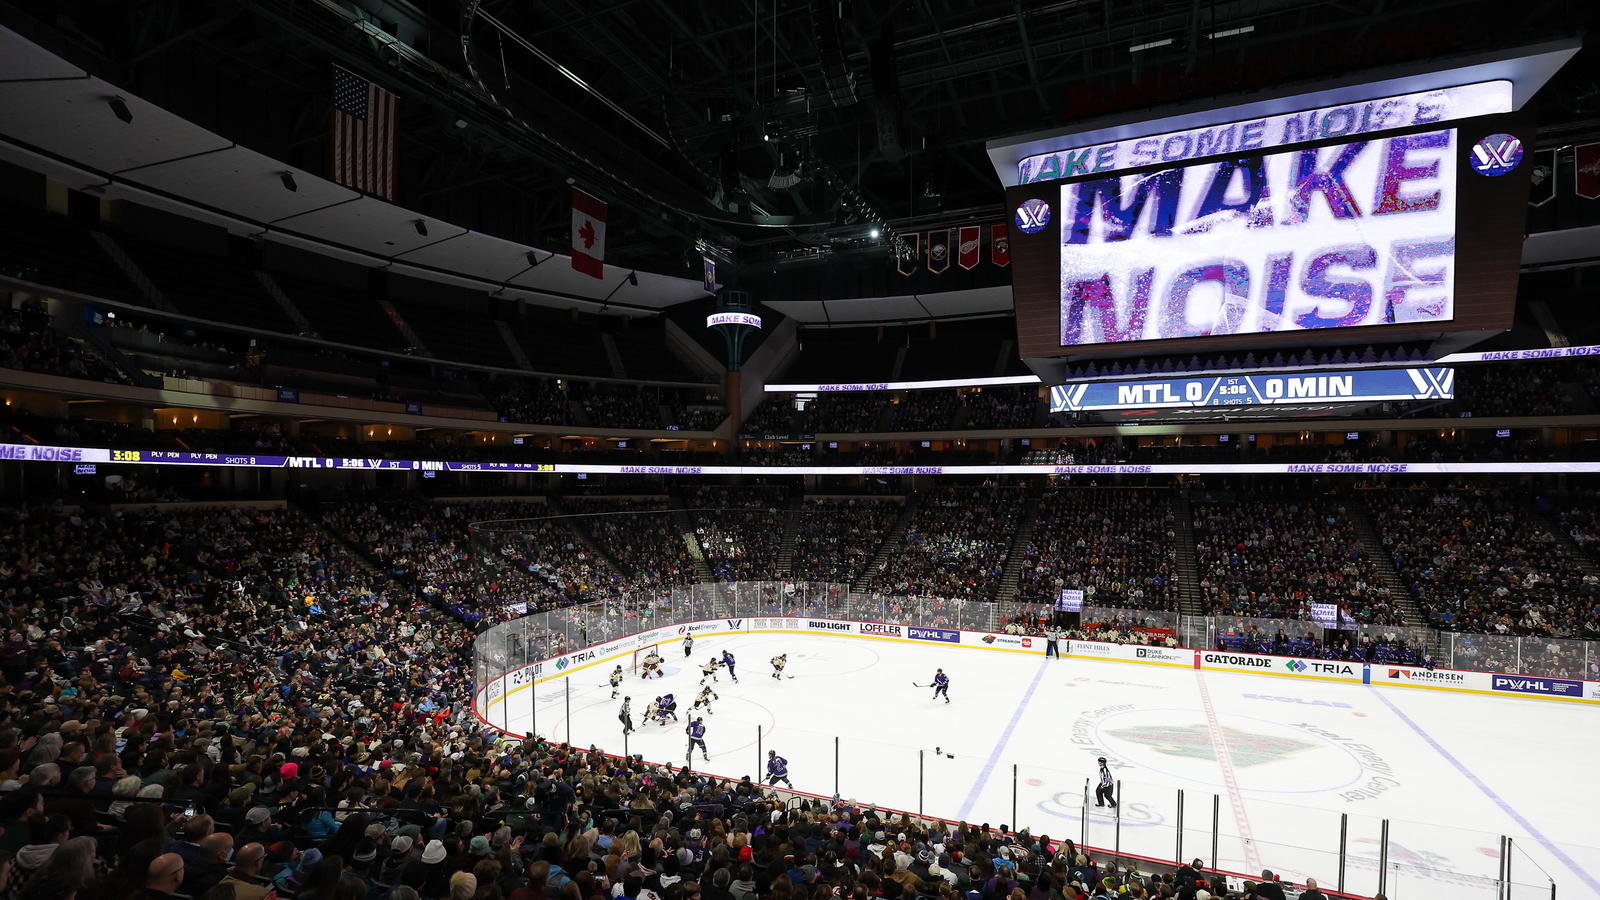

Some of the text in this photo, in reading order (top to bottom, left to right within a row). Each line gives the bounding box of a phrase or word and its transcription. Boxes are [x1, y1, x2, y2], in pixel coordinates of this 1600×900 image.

[1129, 118, 1267, 167] SOME
[1063, 130, 1454, 247] MAKE
[1062, 236, 1456, 346] NOISE
[711, 315, 740, 324] MAKE
[1481, 351, 1519, 360] MAKE
[1522, 349, 1562, 359] SOME
[1118, 382, 1203, 404] MTL 0
[1219, 385, 1247, 395] 5:06
[1265, 376, 1353, 398] 0 MIN
[1213, 398, 1219, 406] 8
[31, 447, 82, 461] NOISE
[113, 450, 141, 461] 3:08
[289, 457, 321, 468] MTL
[325, 458, 333, 468] 0
[342, 458, 364, 467] 5:06
[413, 461, 419, 469] 0
[421, 461, 443, 470] MIN
[1119, 465, 1152, 473] NOISE
[1287, 463, 1408, 472] MAKE SOME NOISE
[675, 466, 702, 474] NOISE
[889, 466, 914, 474] SOME
[915, 466, 942, 474] NOISE
[809, 621, 851, 631] BUD LIGHT
[860, 623, 901, 634] LOFFLER
[638, 631, 659, 642] Schneider
[909, 629, 941, 639] PWHL
[606, 645, 619, 653] bread
[571, 651, 596, 664] TRIA
[1204, 654, 1272, 668] GATORADE
[1311, 662, 1354, 675] TRIA
[1411, 671, 1464, 680] ANDERSEN
[1496, 678, 1549, 691] PWHL
[1242, 693, 1354, 709] ECOLAB
[1081, 703, 1135, 719] Center
[1288, 722, 1401, 803] Xcel Energy Center
[1052, 791, 1153, 820] CS
